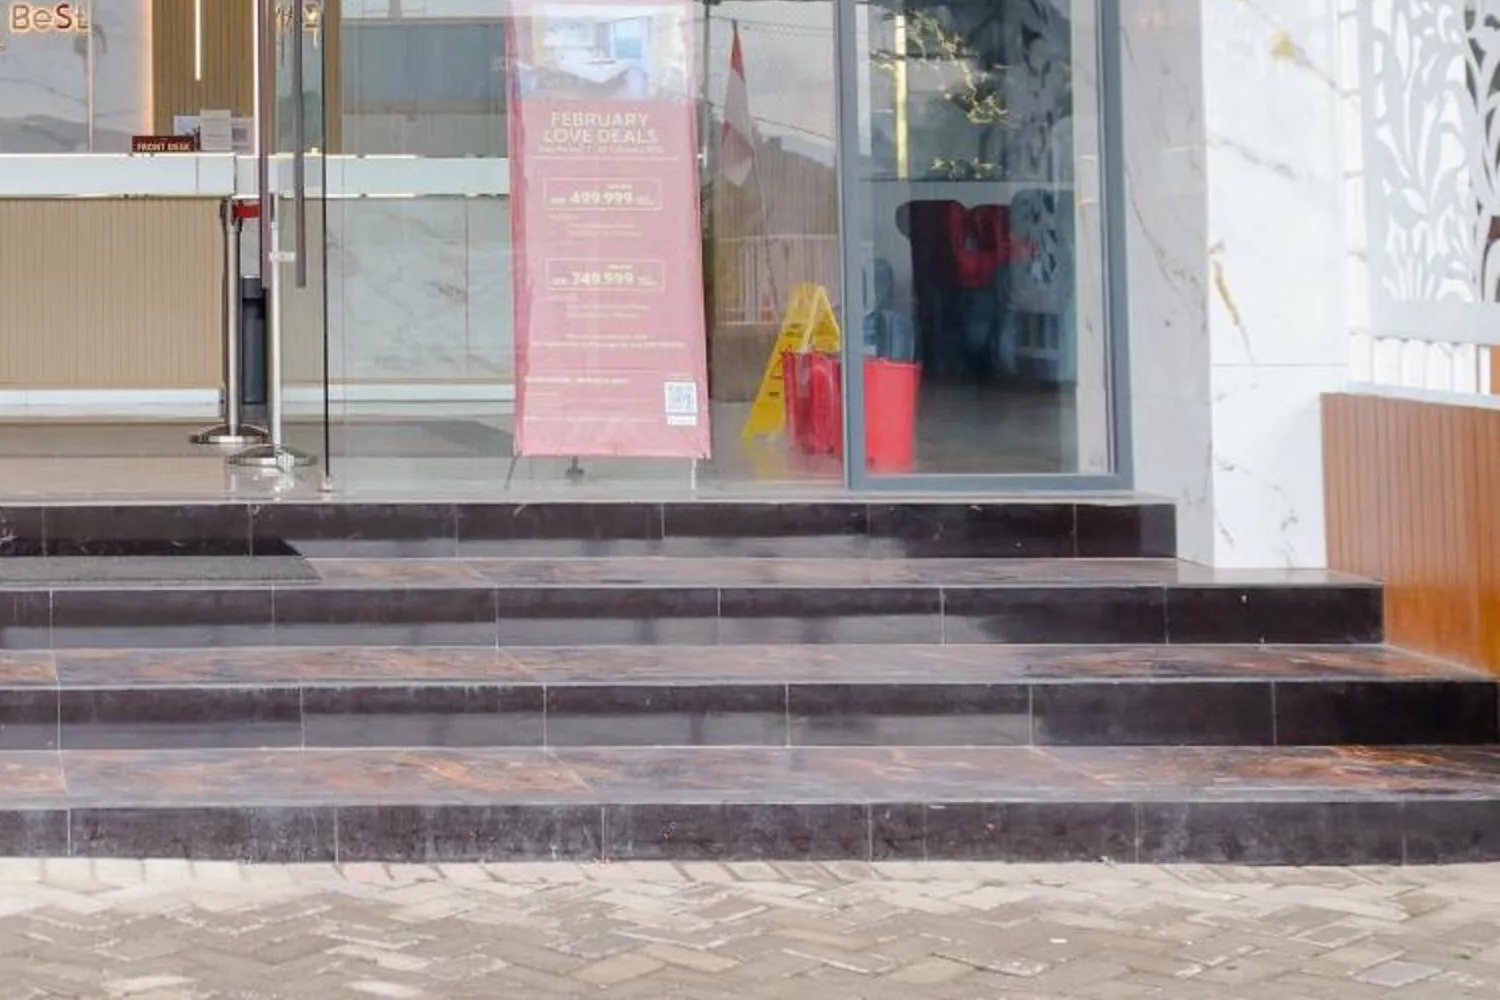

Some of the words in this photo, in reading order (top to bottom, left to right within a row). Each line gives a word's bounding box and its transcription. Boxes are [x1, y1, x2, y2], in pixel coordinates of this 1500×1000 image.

[550, 111, 650, 128] FEBRUARY
[543, 127, 593, 144] LOVE
[597, 128, 659, 145] DEALS
